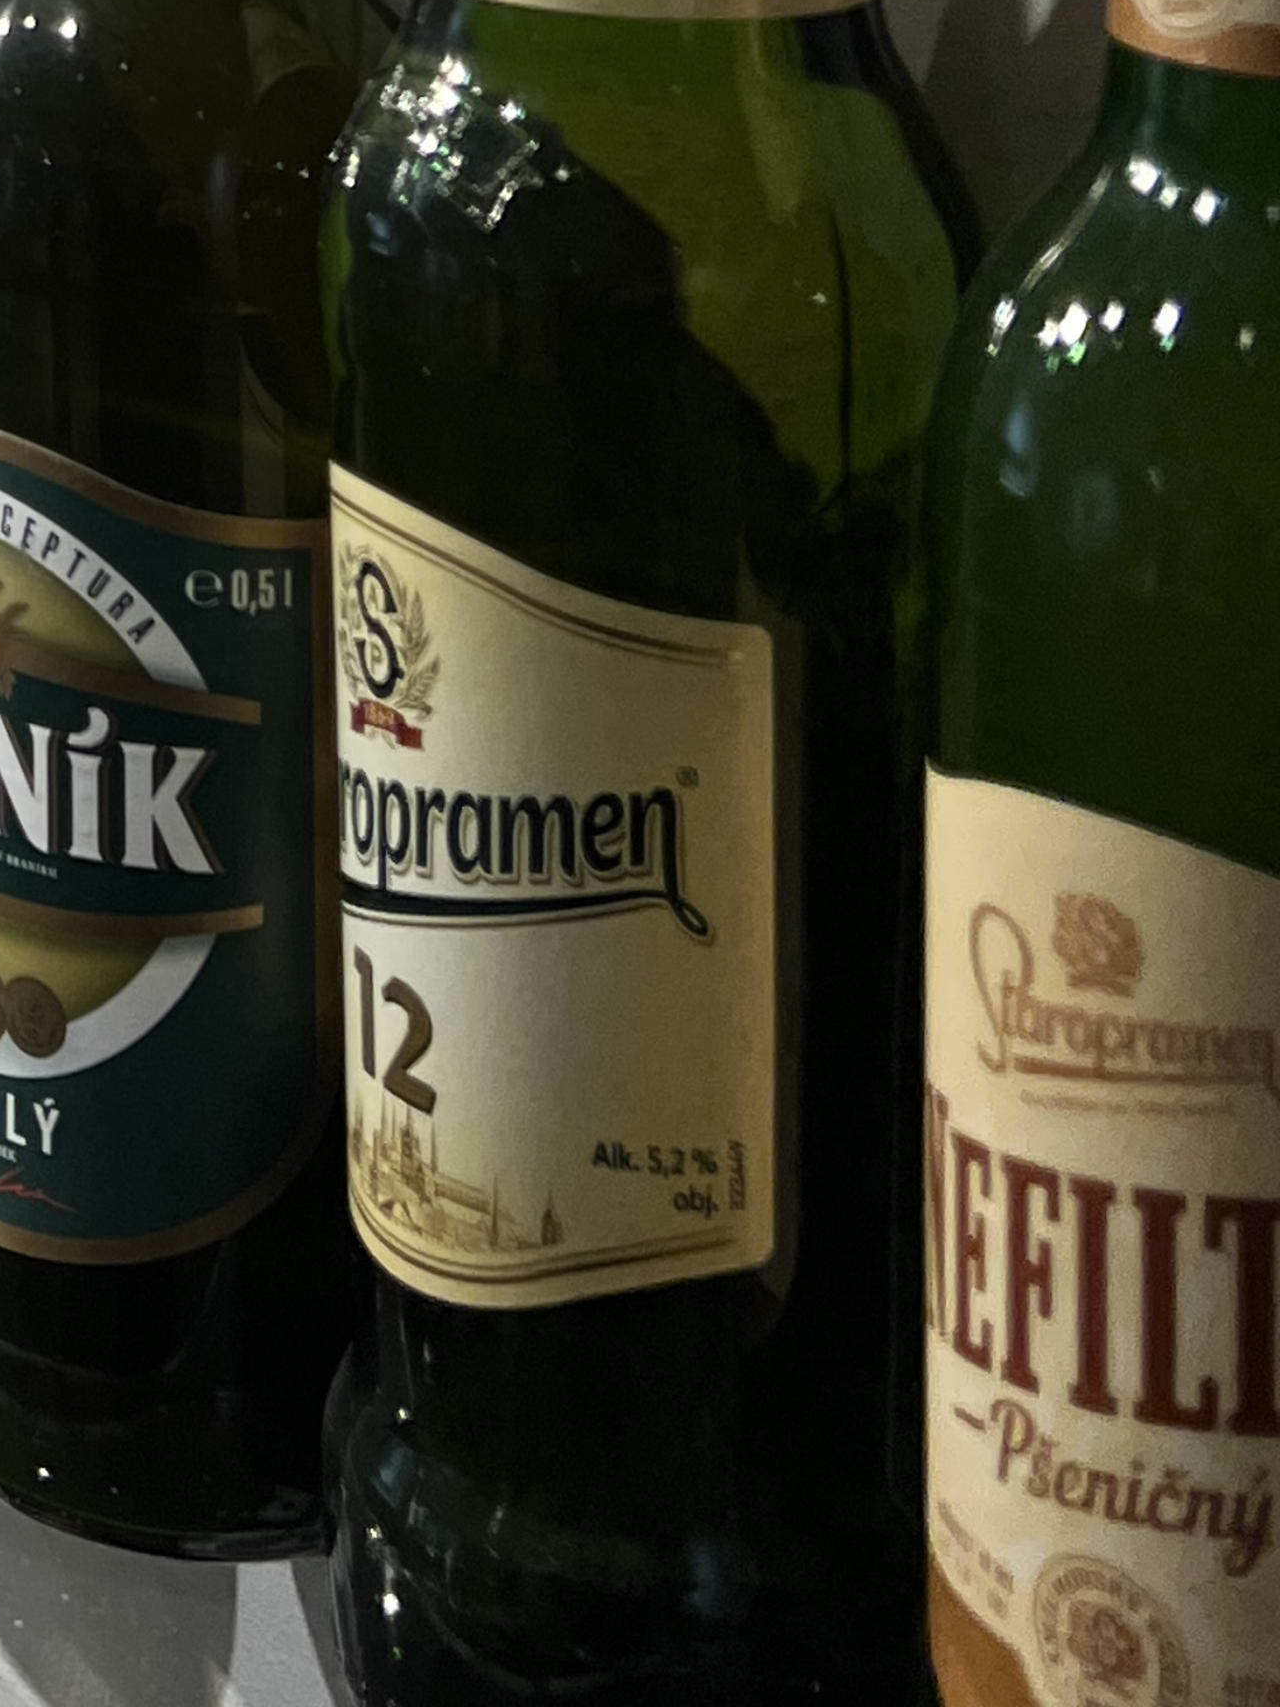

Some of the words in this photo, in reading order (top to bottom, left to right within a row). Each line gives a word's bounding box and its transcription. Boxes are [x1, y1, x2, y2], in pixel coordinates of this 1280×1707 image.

[353, 942, 440, 1117] 12
[592, 1140, 641, 1174] Alk.
[672, 1188, 719, 1221] obj.
